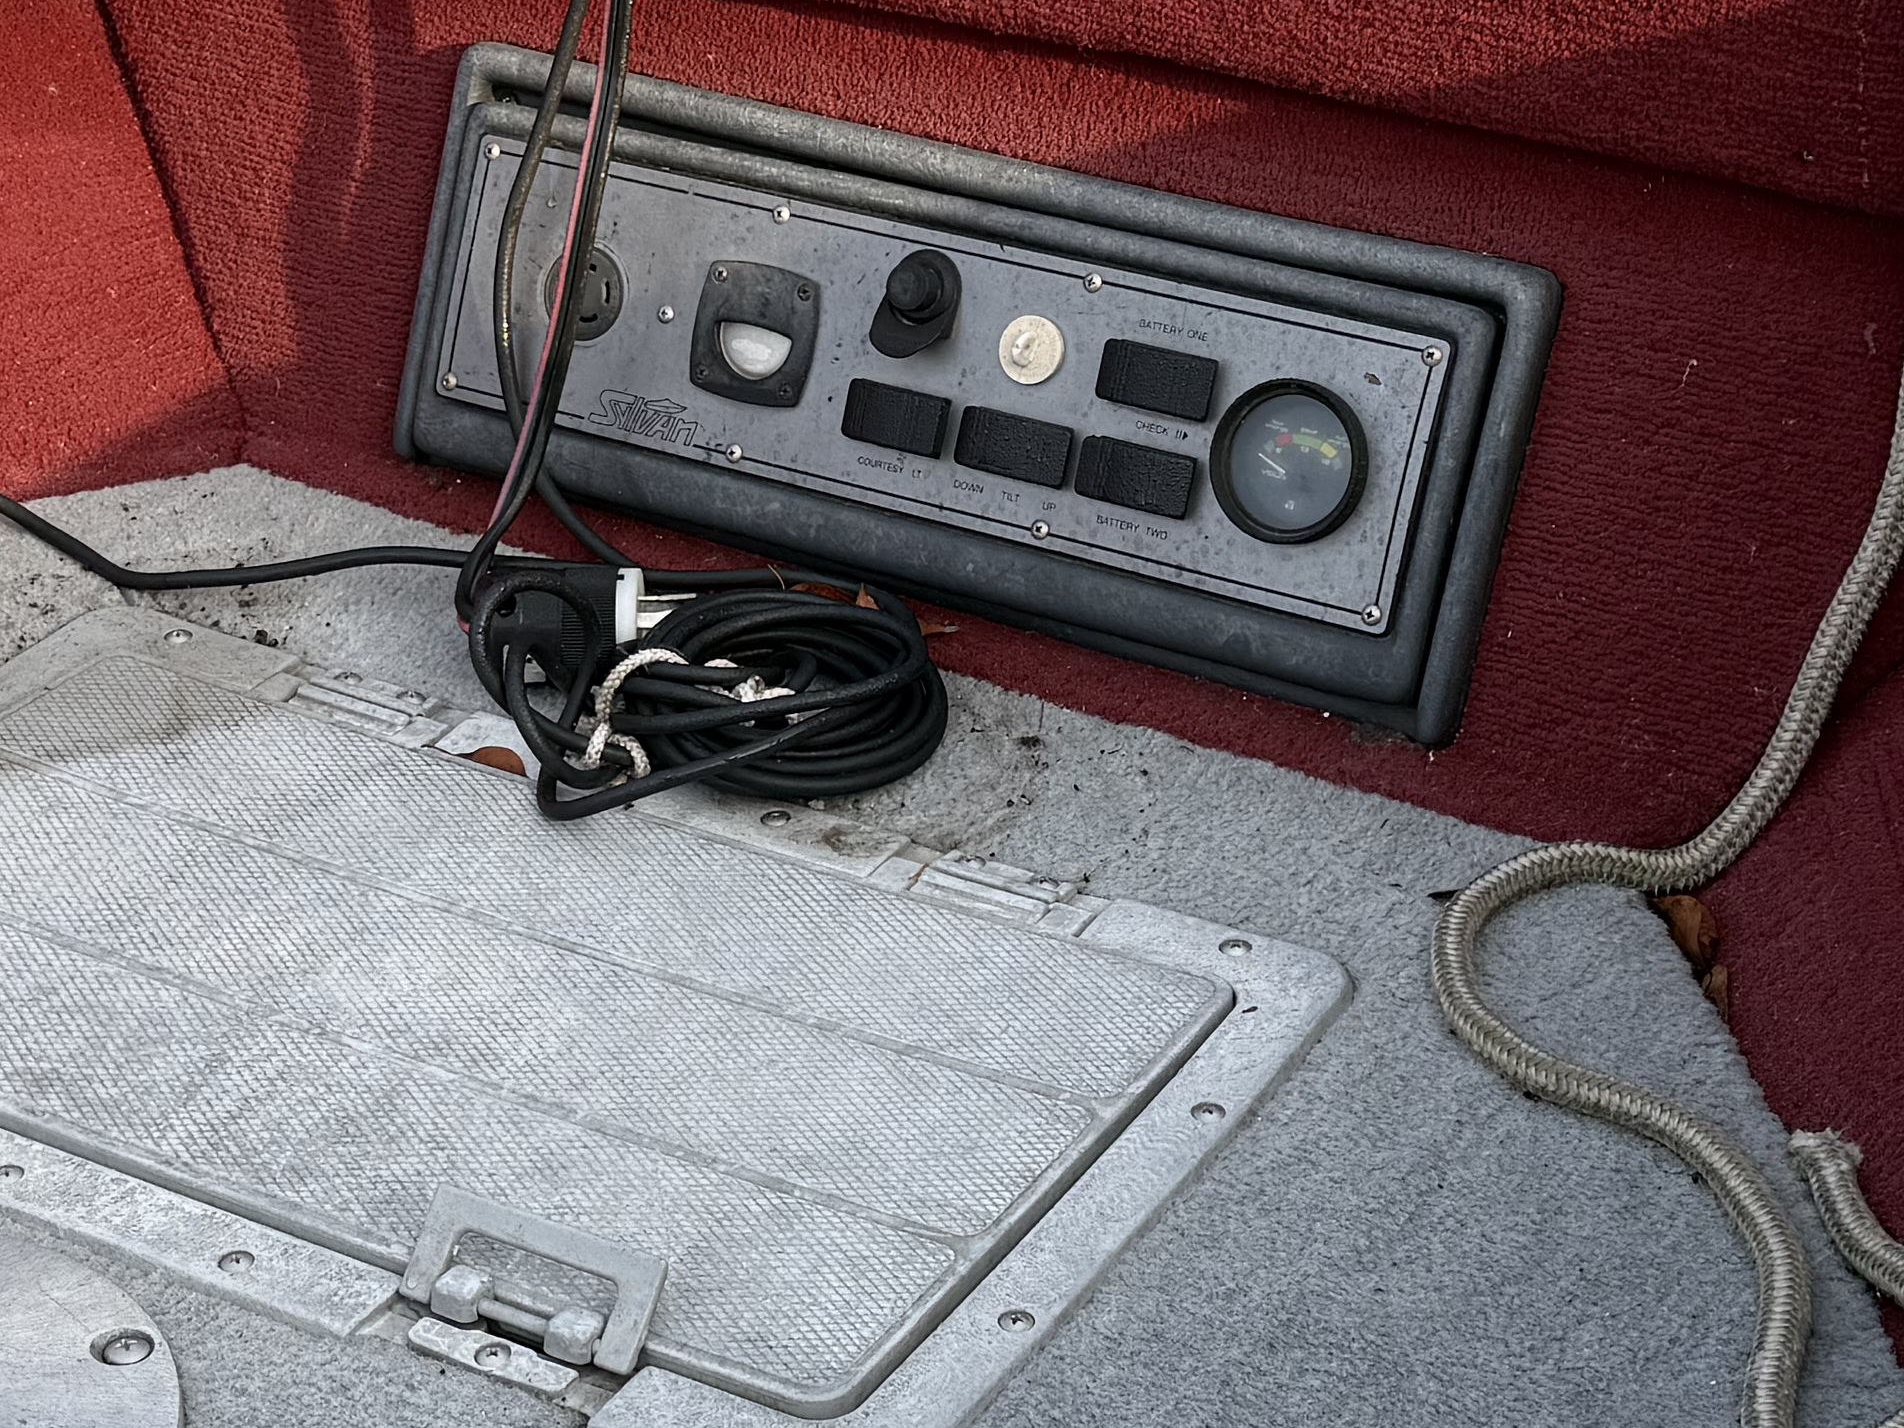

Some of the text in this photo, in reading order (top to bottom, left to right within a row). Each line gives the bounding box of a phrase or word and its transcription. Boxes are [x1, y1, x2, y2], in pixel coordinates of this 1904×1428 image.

[1139, 318, 1208, 342] BATTERY ONE
[1136, 420, 1170, 436] CHECK
[857, 456, 904, 474] COURTESY
[953, 479, 1057, 512] DOWN TILT UP
[1096, 514, 1168, 540] BATTERY TWO
